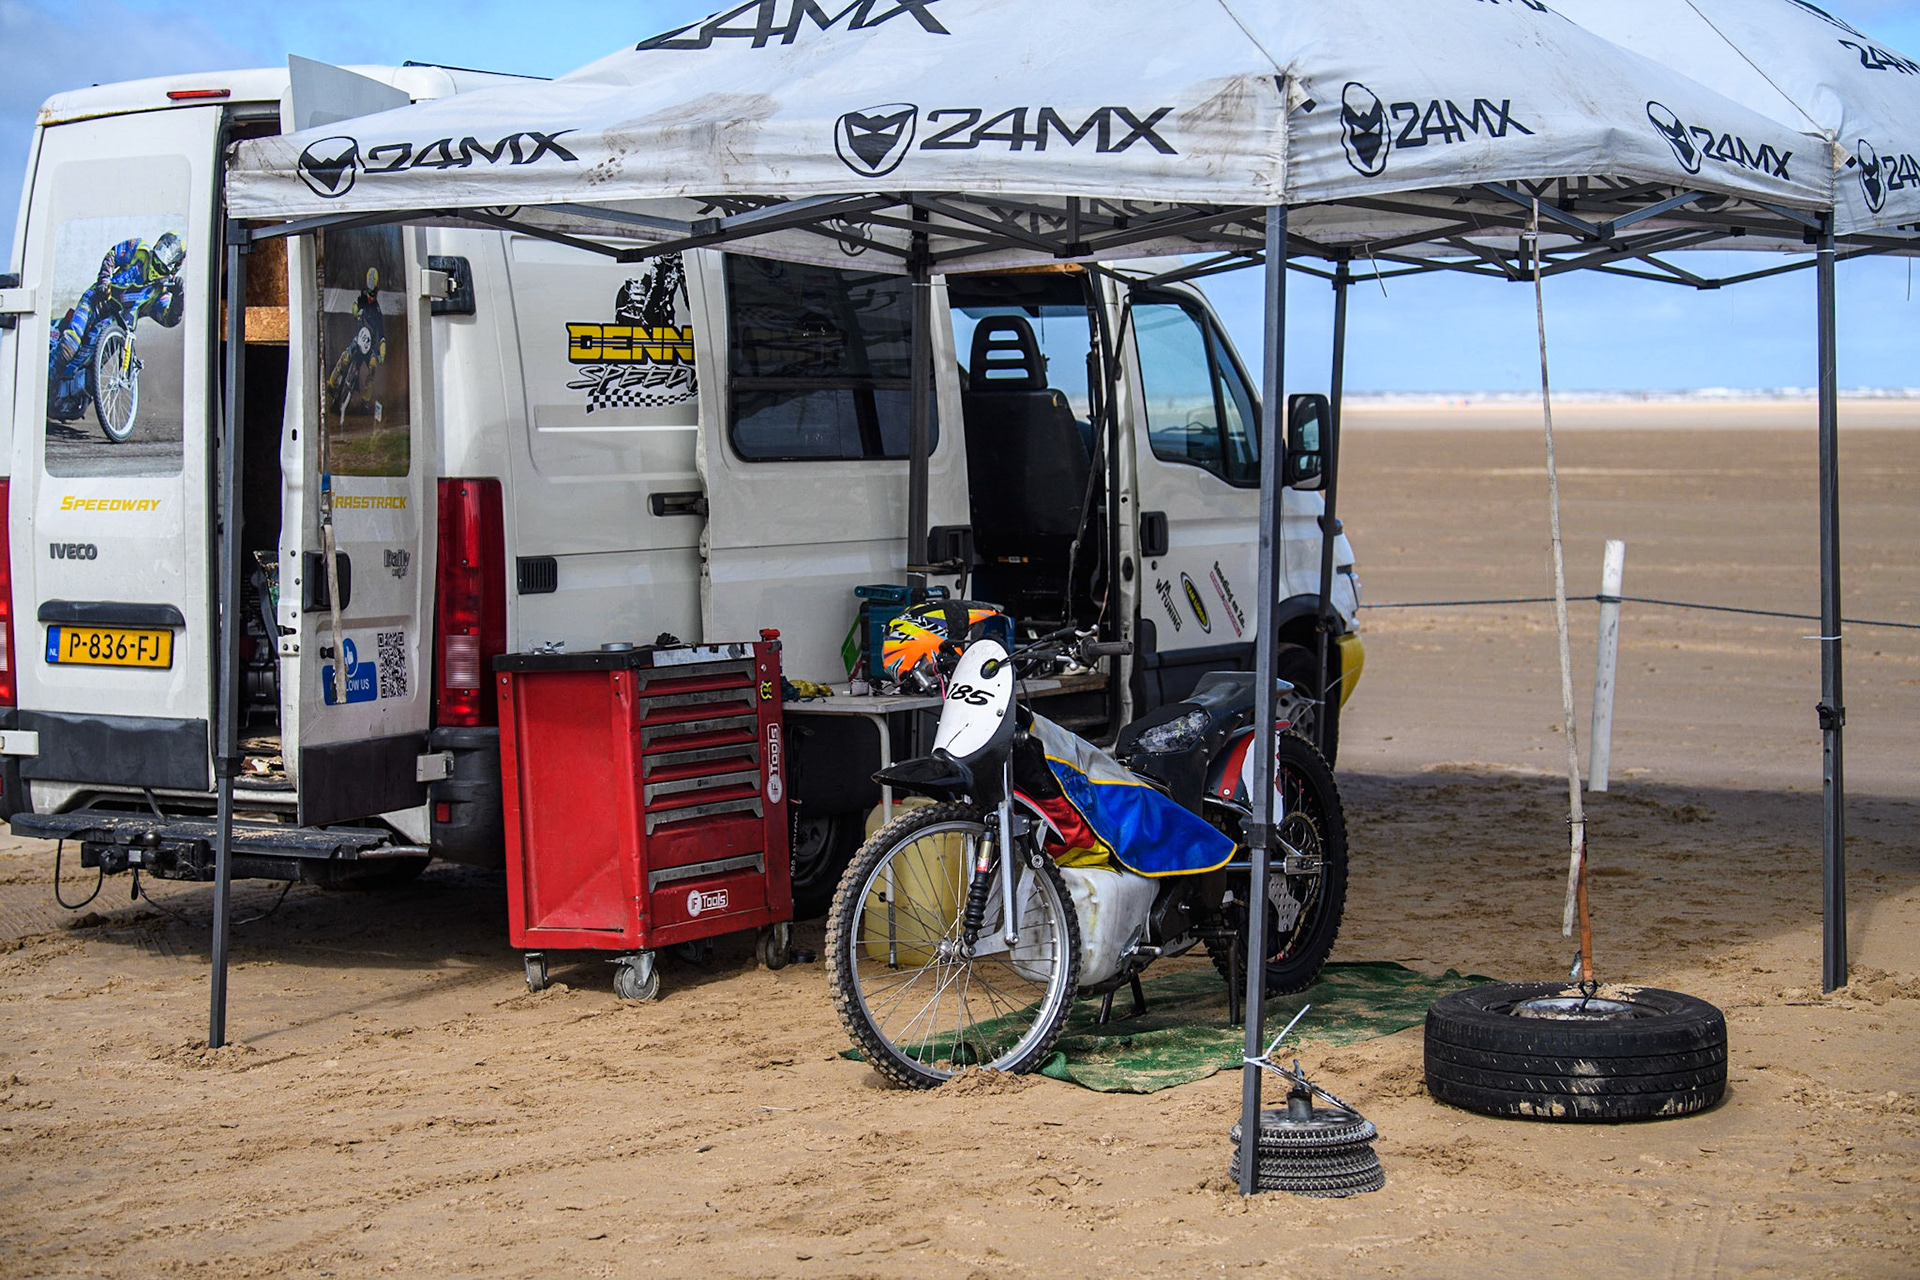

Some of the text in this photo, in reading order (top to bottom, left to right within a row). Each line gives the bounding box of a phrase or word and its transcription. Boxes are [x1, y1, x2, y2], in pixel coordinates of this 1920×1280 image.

[919, 106, 1179, 155] 24MX
[1390, 98, 1536, 149] 24MX
[363, 128, 580, 173] 24MX
[1689, 125, 1793, 181] 24MX
[565, 322, 698, 365] DENN
[49, 543, 98, 560] IVECO
[384, 549, 411, 567] Daily
[49, 648, 58, 656] NL
[69, 632, 160, 662] P-836-FJ
[360, 678, 370, 690] US
[946, 683, 995, 706] 185
[769, 727, 780, 772] Tools
[702, 892, 726, 908] Tools
